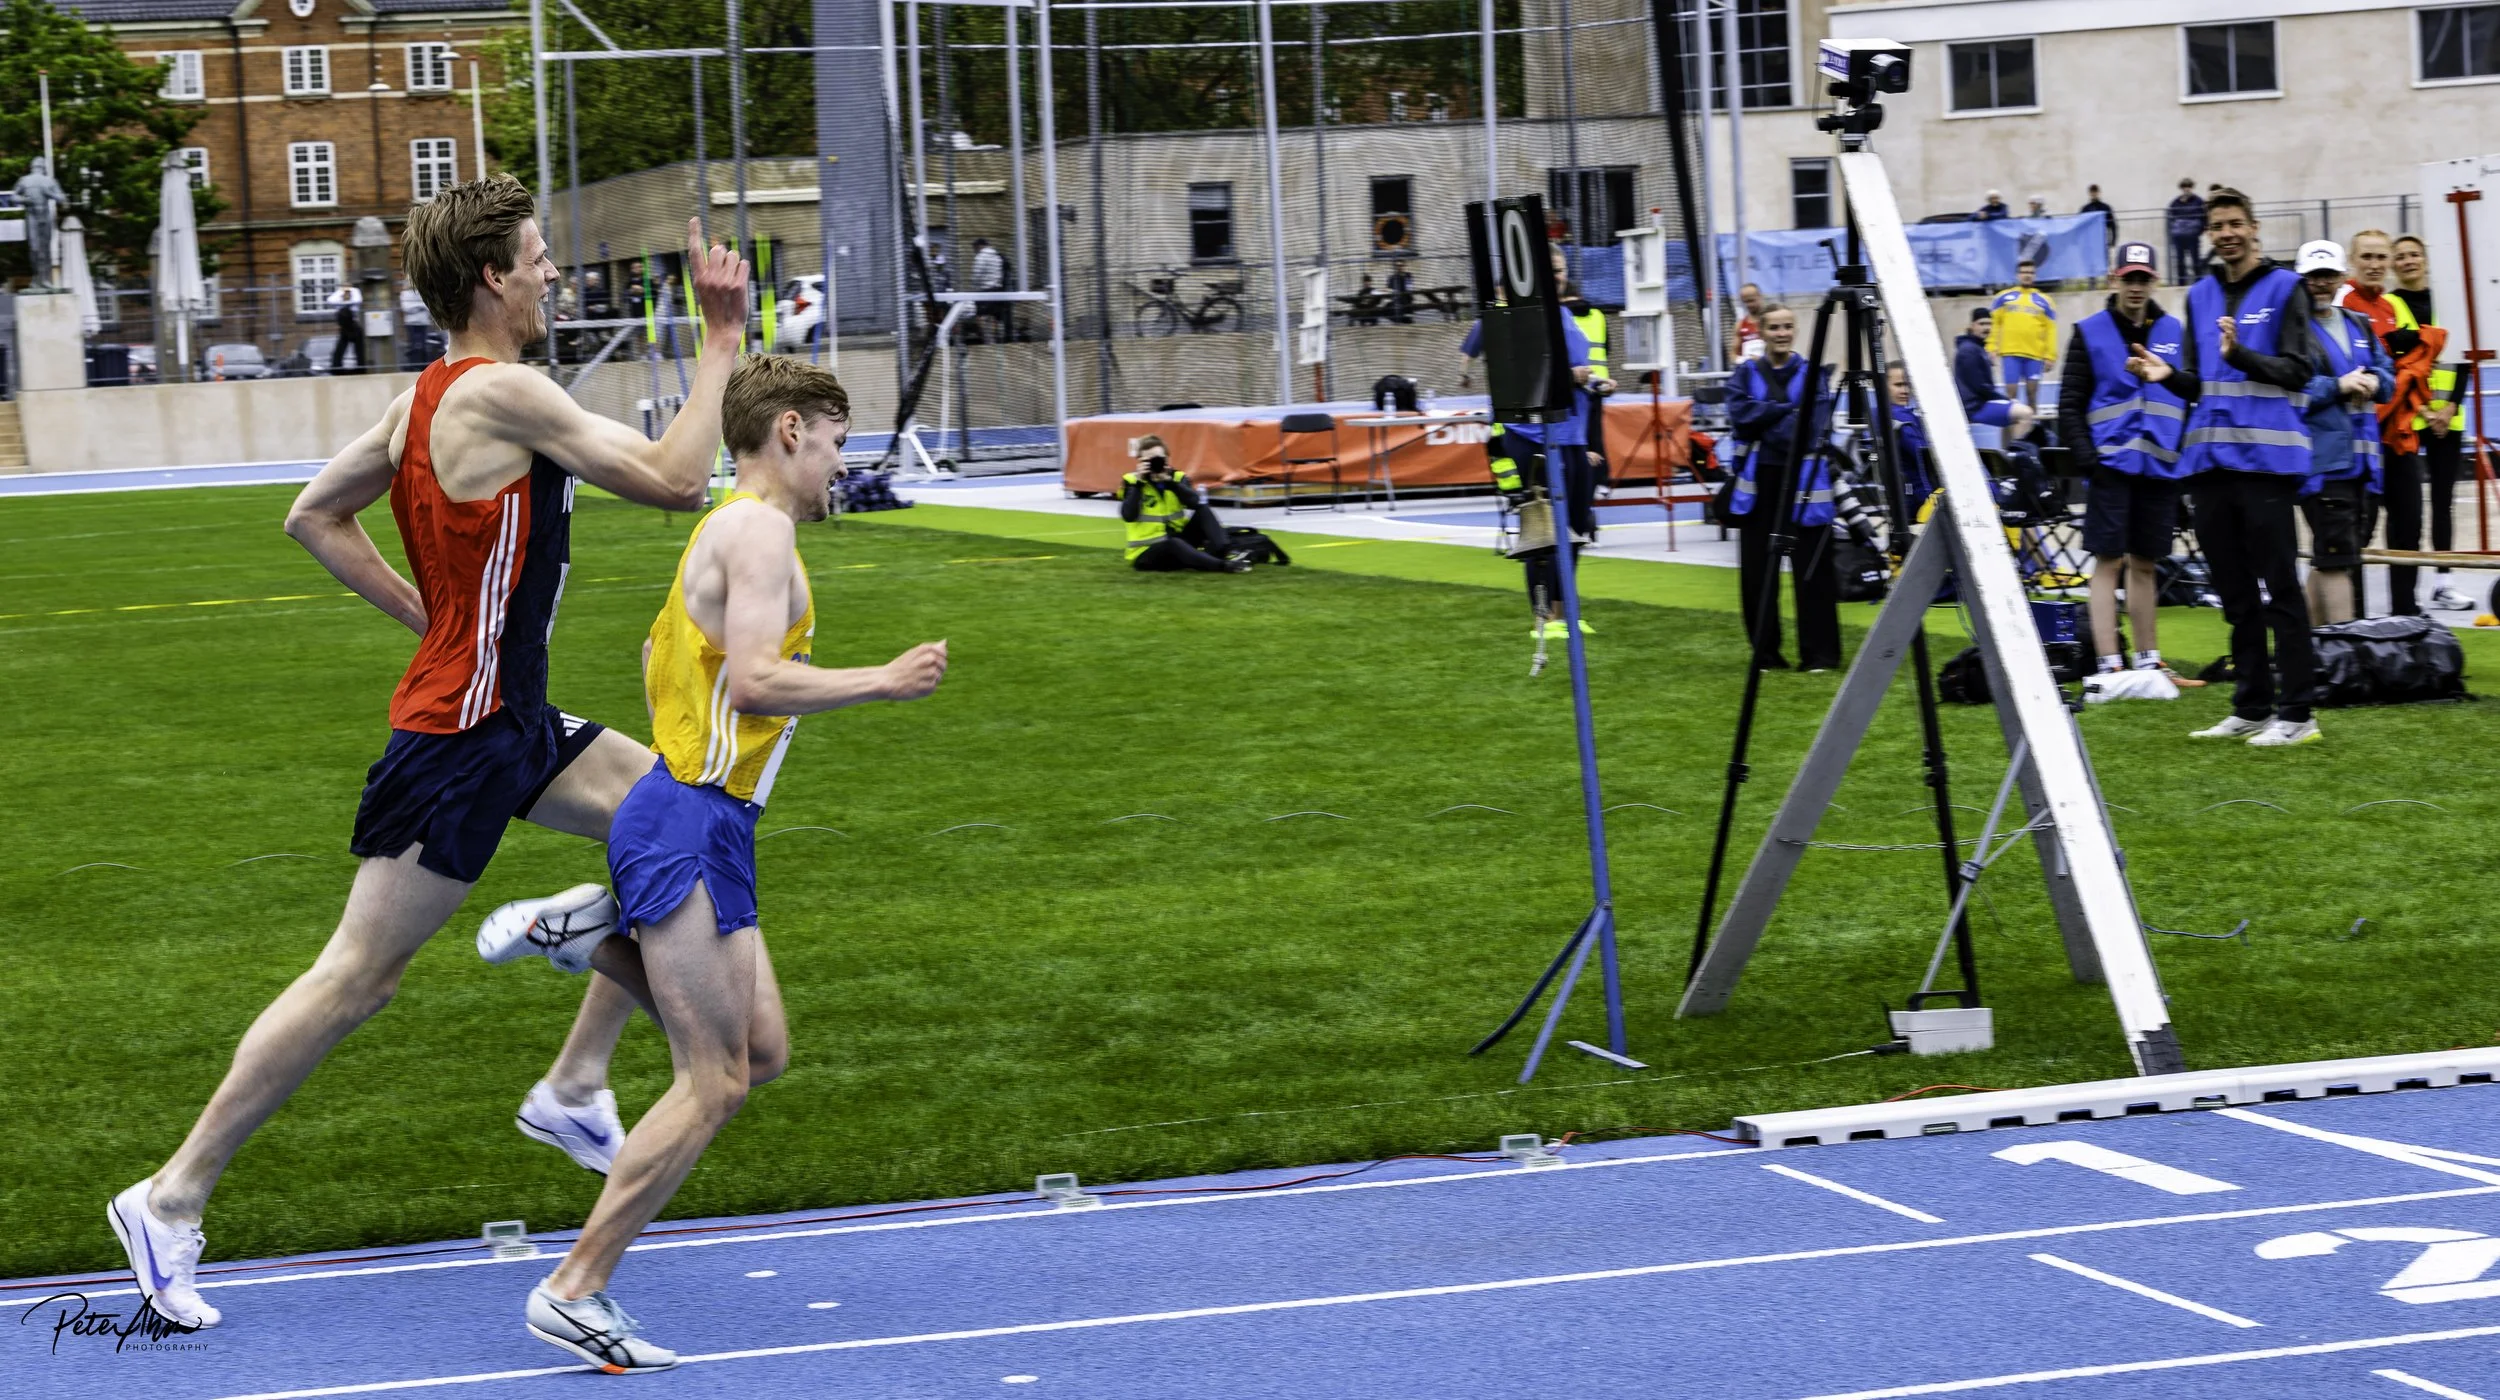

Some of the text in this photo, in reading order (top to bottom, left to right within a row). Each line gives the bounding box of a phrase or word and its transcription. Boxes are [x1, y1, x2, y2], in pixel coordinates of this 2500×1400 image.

[1502, 209, 1535, 298] 0
[1988, 1140, 2244, 1196] 1
[2253, 1227, 2500, 1305] 2
